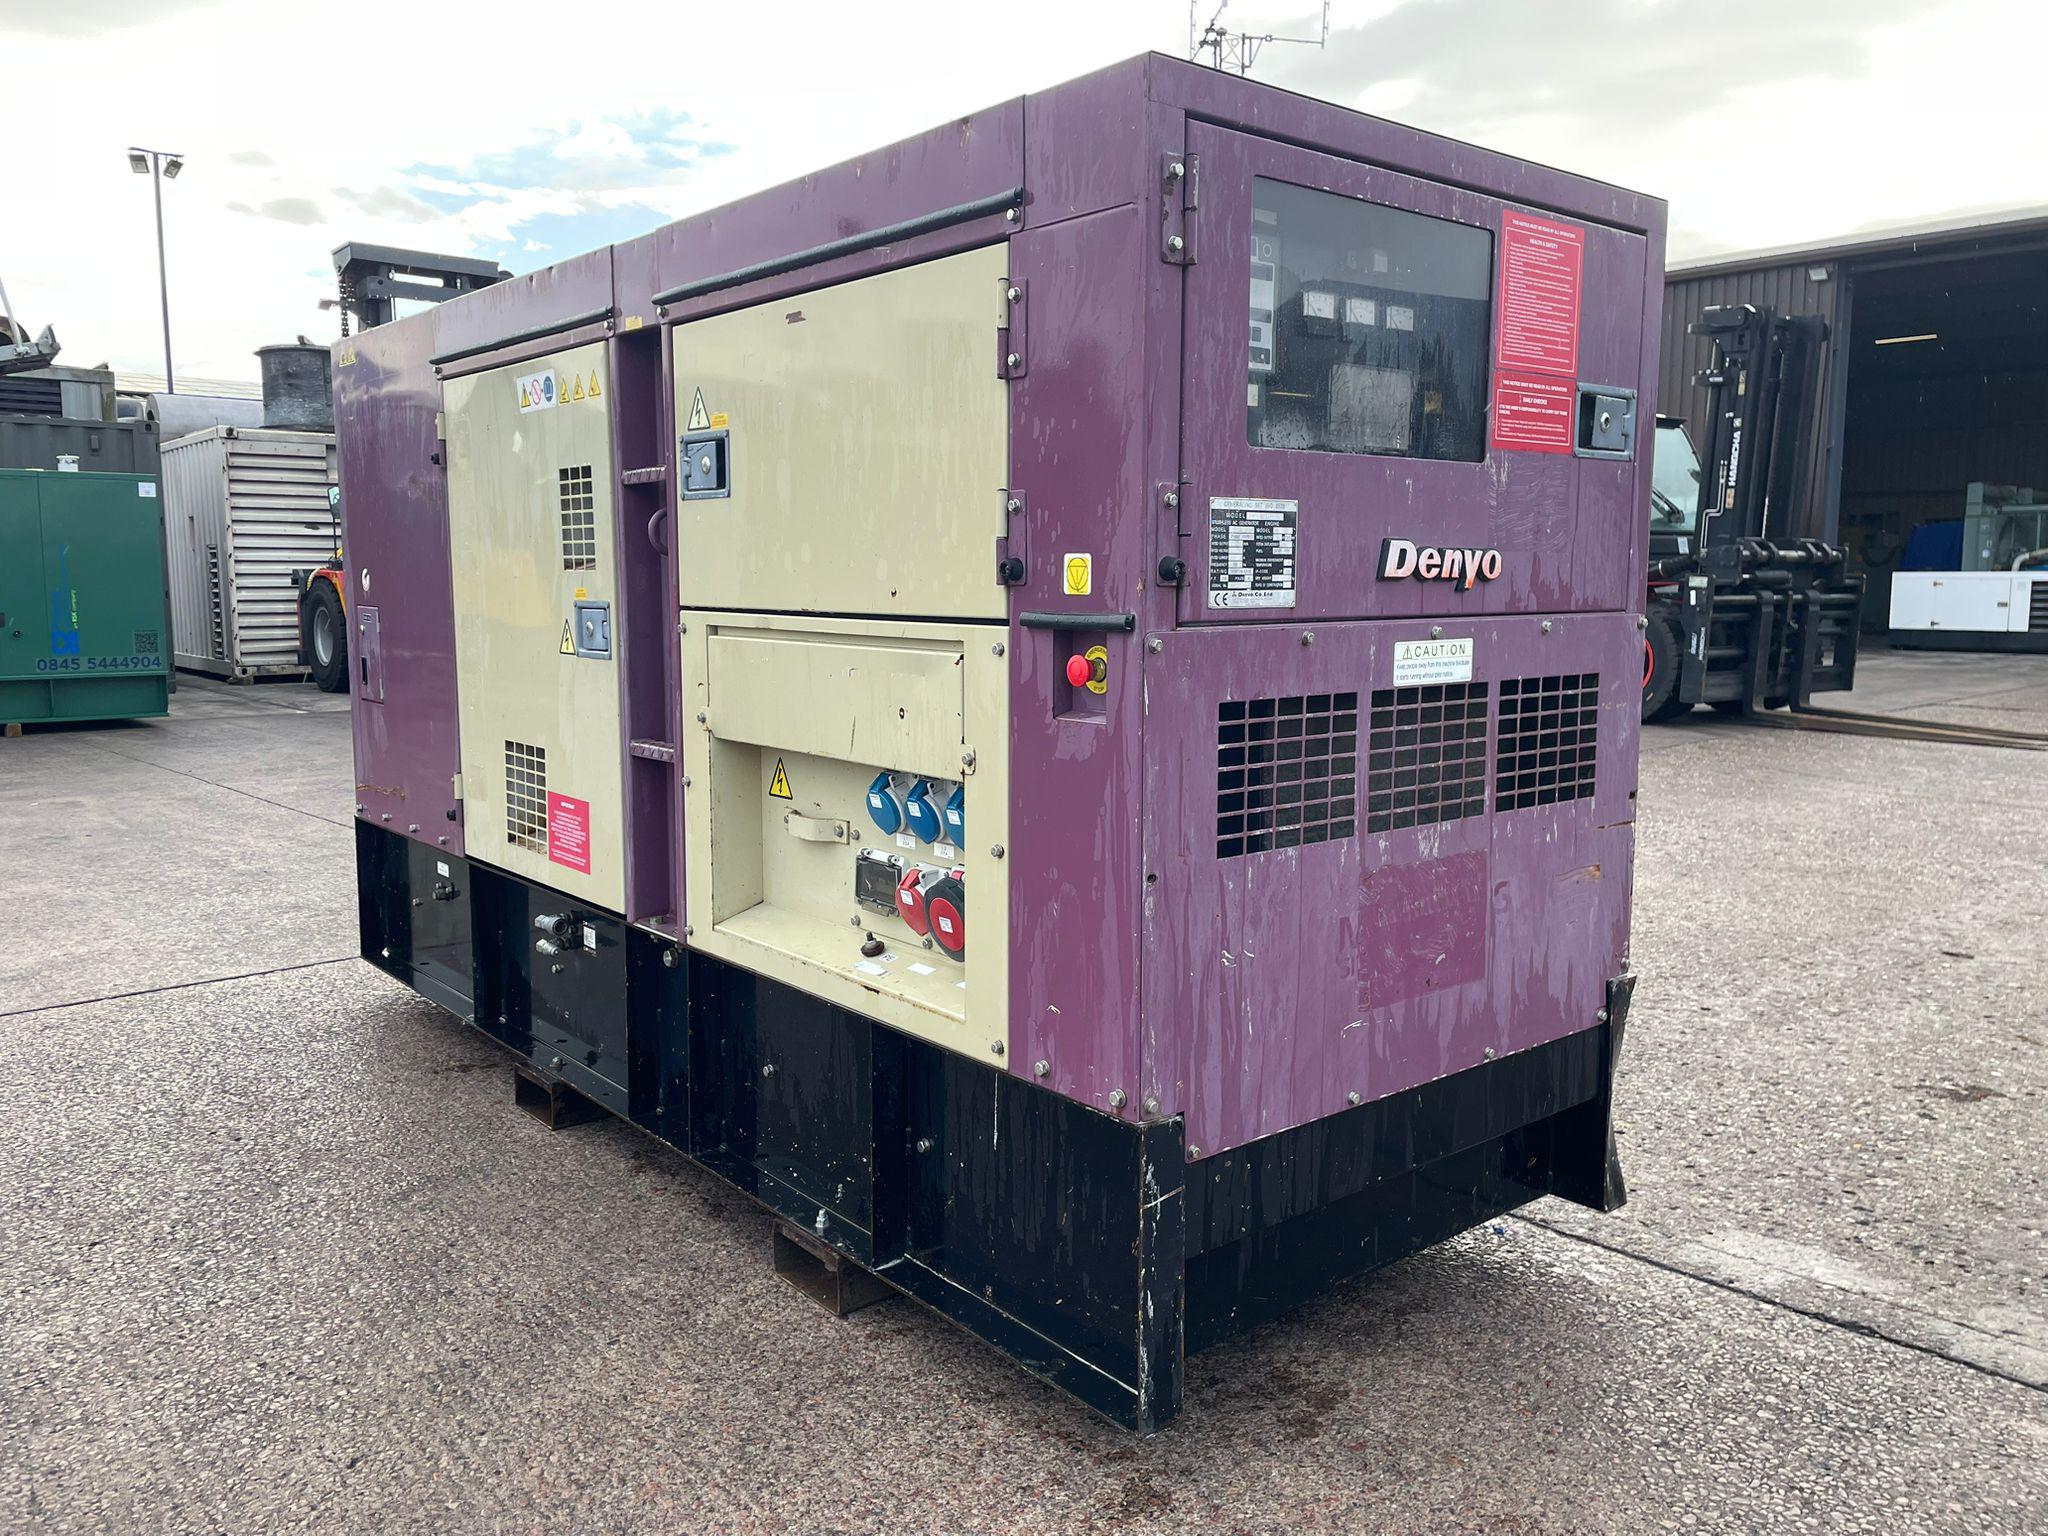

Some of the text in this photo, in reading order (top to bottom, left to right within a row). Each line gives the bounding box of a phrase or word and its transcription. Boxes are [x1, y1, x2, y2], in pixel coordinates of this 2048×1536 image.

[1379, 538, 1502, 590] Denyo
[1414, 644, 1466, 657] CAUTION
[37, 656, 162, 672] 0845 5444904
